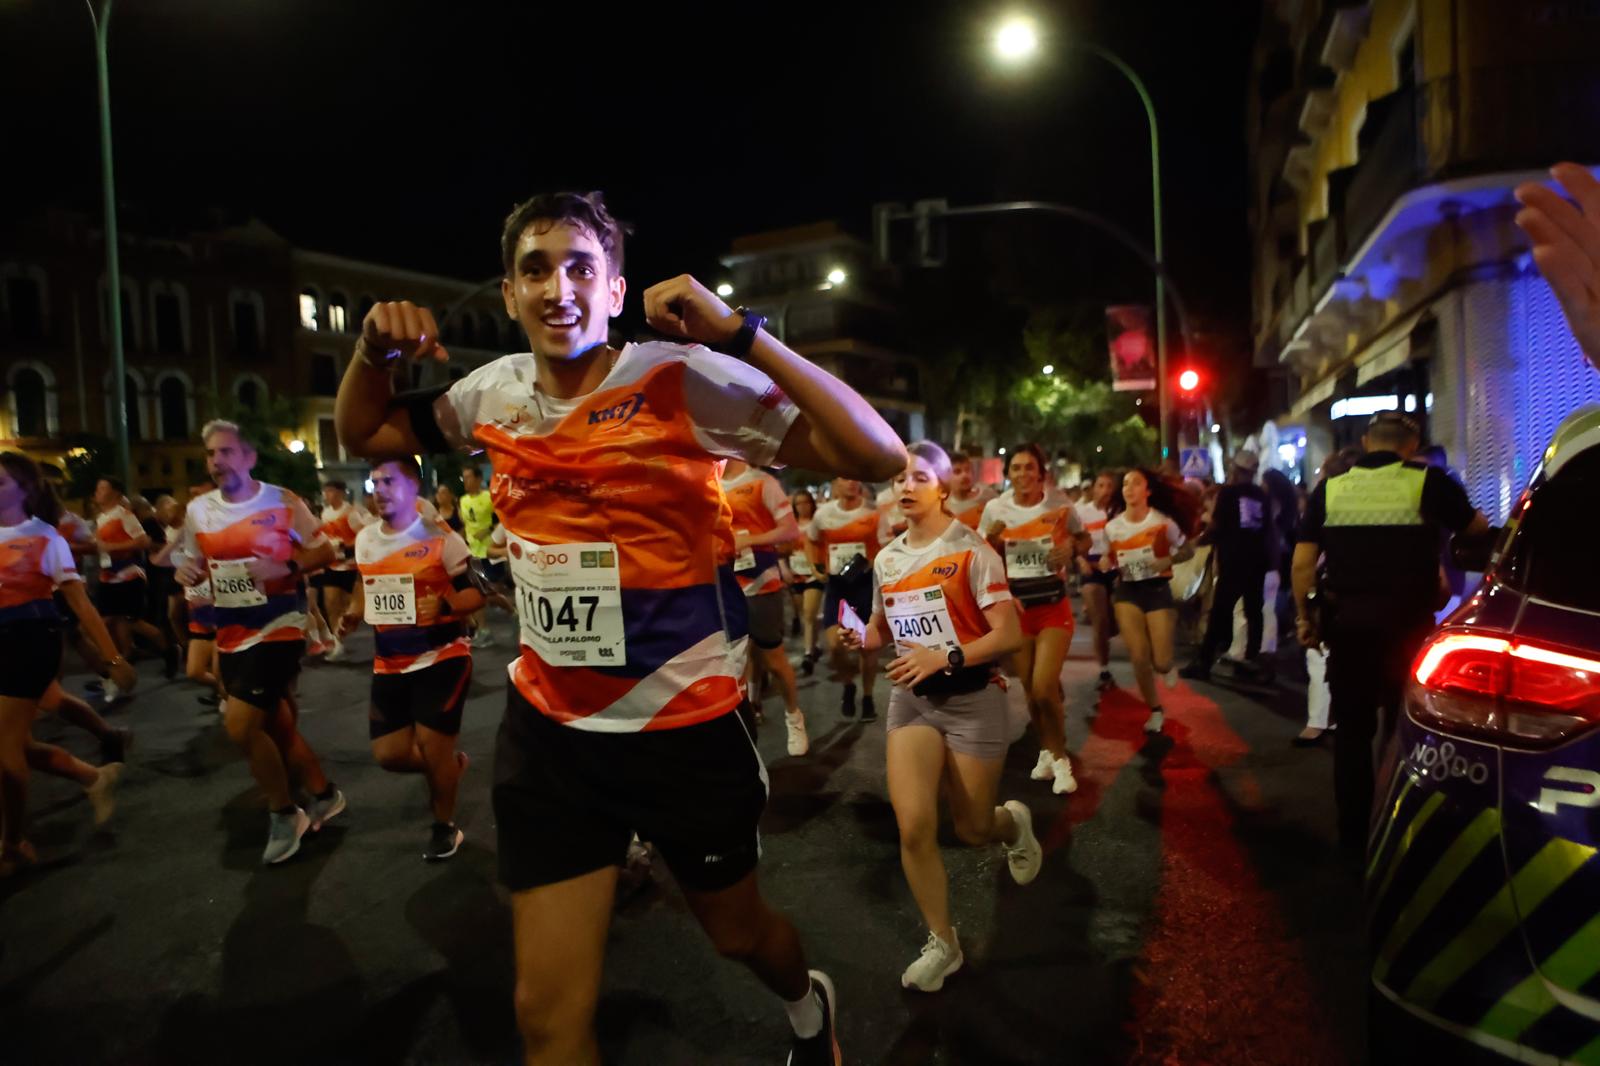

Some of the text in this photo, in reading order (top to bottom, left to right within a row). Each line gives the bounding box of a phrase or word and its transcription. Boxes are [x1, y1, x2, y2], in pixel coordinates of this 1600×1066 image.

[374, 594, 405, 611] 9108
[520, 585, 599, 633] 11047
[894, 614, 943, 638] 24001
[565, 635, 601, 643] PALOMO
